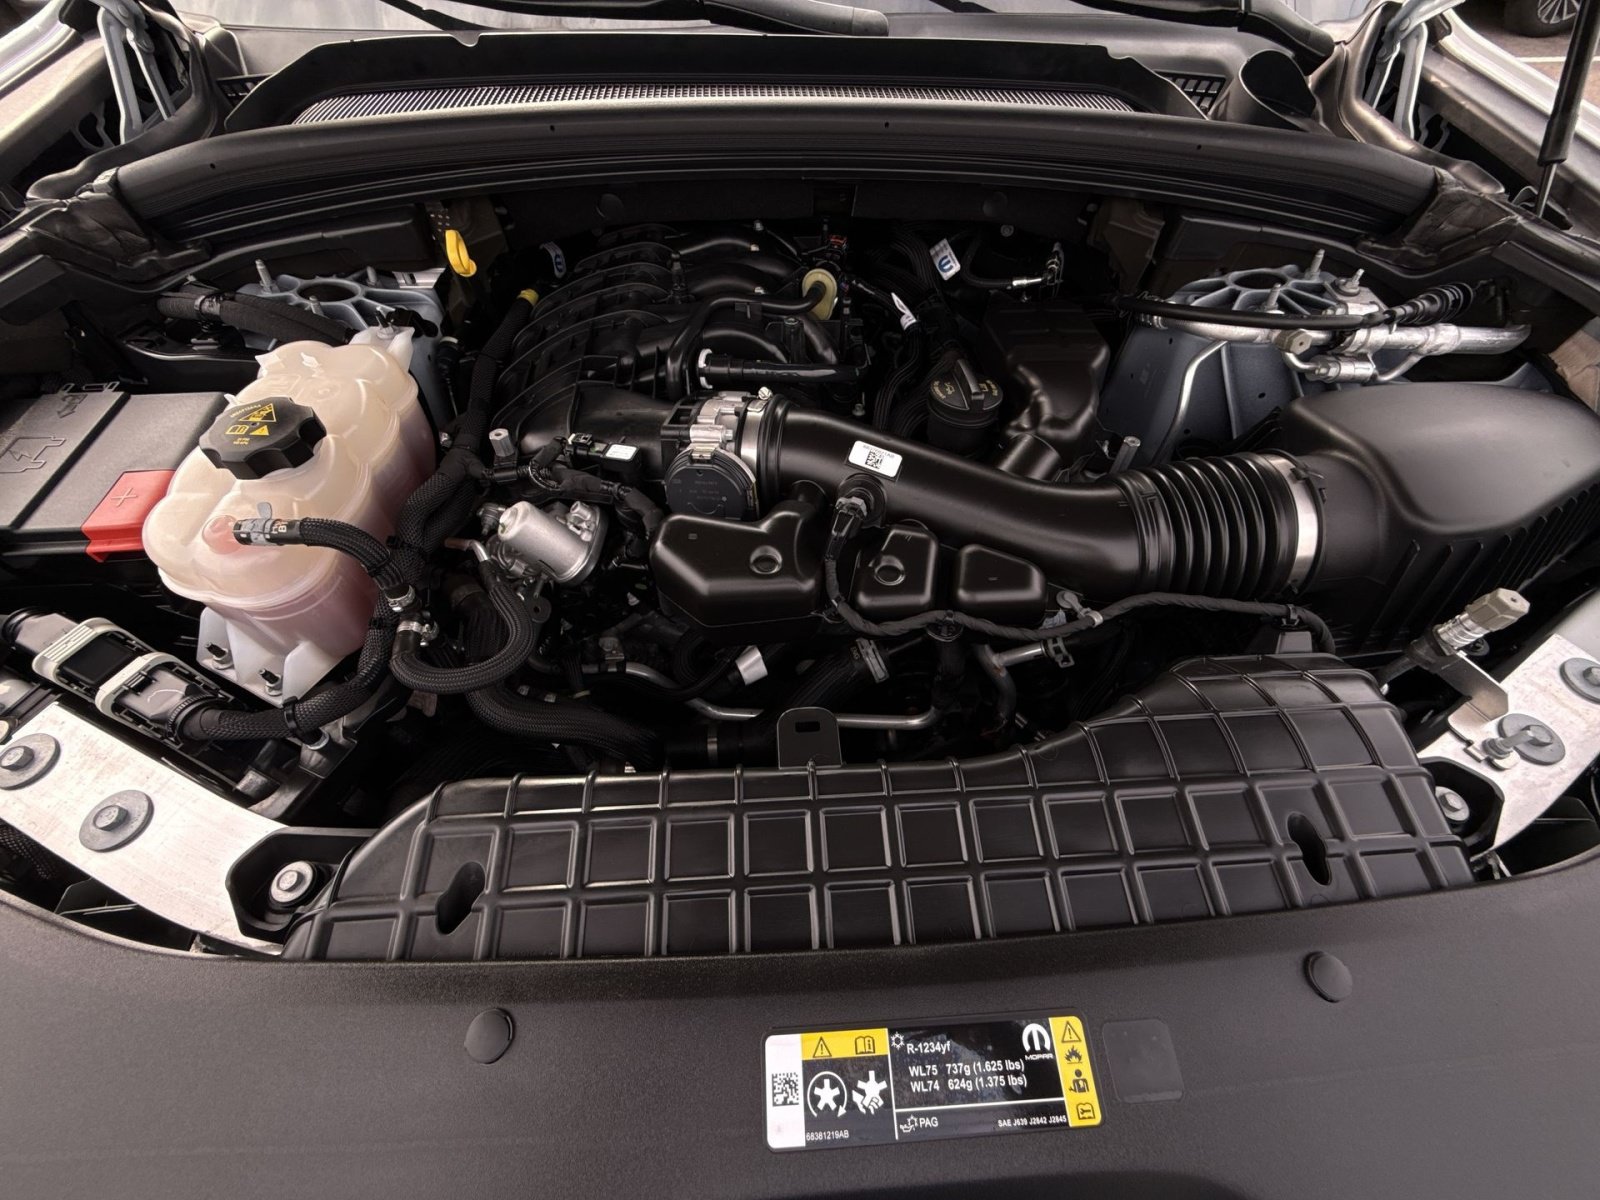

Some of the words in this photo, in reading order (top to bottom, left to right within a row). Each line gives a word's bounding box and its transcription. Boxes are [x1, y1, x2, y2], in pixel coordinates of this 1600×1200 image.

[906, 1040, 951, 1055] R-1234yf
[1024, 1053, 1054, 1061] MOPAR
[908, 1064, 939, 1077] WL75
[945, 1062, 971, 1076] 737g
[973, 1060, 1003, 1075] (1.625
[1004, 1058, 1025, 1072] lbs)
[910, 1079, 940, 1093] WL74
[947, 1077, 973, 1091] 624g
[975, 1075, 1006, 1091] (1.375
[1007, 1073, 1028, 1088] lbs)
[919, 1116, 939, 1129] PAG
[997, 1118, 1012, 1128] SAE
[1013, 1117, 1028, 1127] J639
[1029, 1116, 1048, 1125] J2842
[1048, 1114, 1067, 1124] J2845
[805, 1129, 850, 1141] 68381219AB
